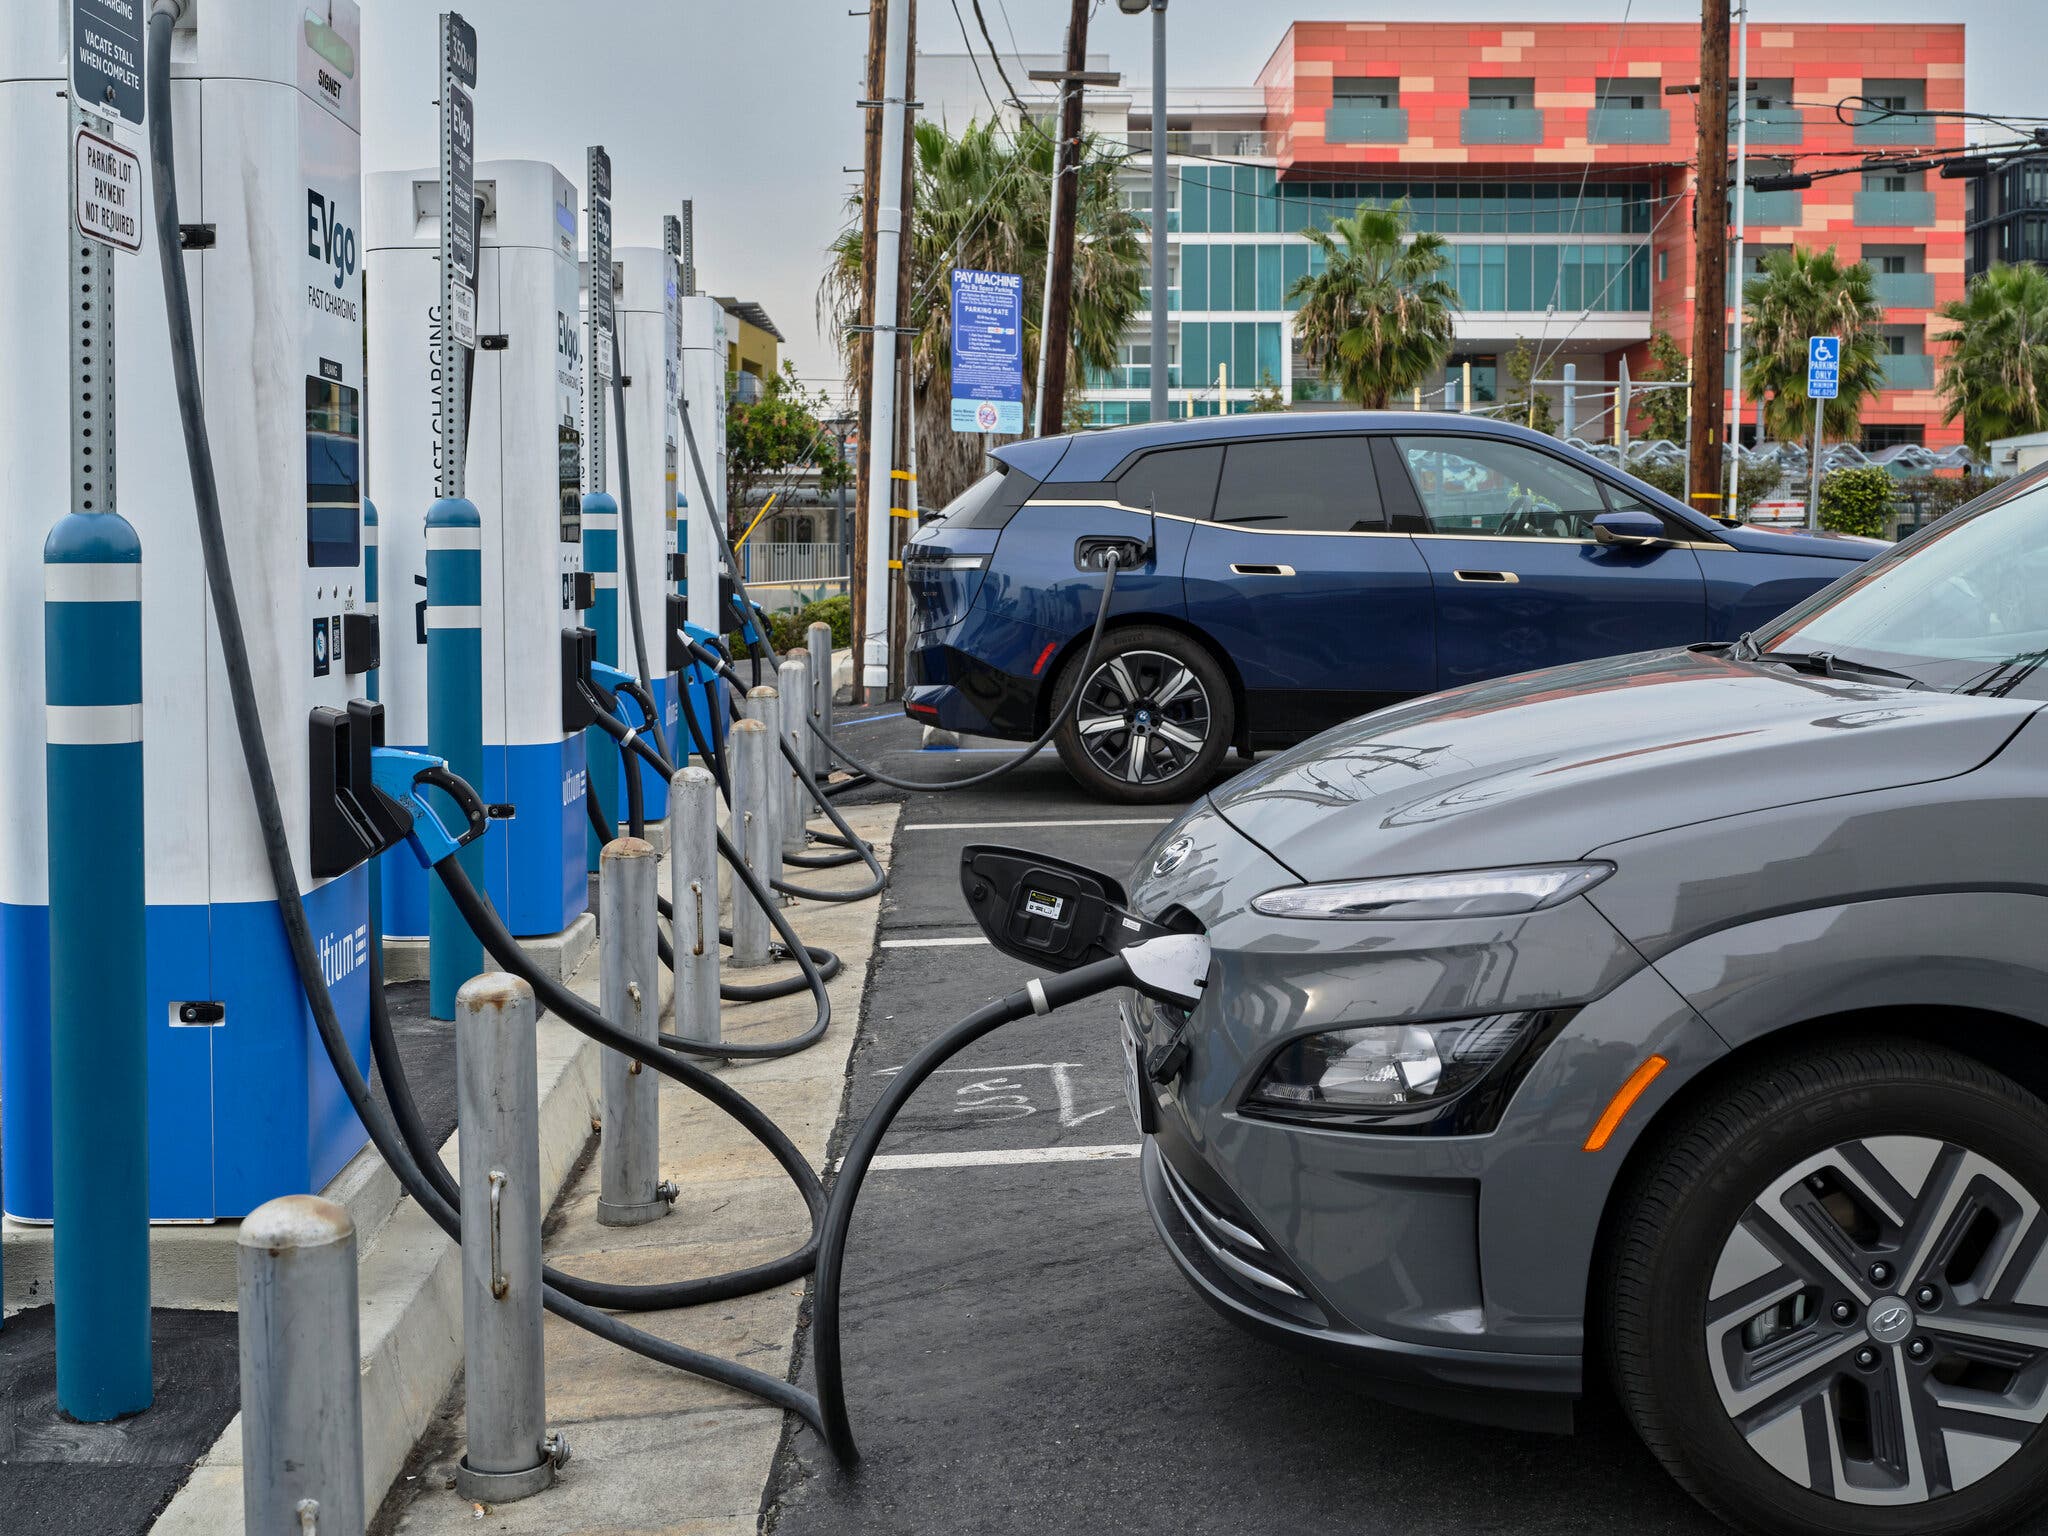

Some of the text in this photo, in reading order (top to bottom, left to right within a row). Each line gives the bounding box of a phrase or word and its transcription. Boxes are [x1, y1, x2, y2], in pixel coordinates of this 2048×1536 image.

[98, 0, 133, 20] ARGING
[85, 29, 135, 68] VACATE STALL
[80, 47, 140, 90] WHEN COMPLETE
[318, 69, 342, 100] SIGNET
[453, 103, 470, 148] EVgo
[87, 146, 131, 184] PARKING LOT
[94, 177, 125, 207] PAYMENT
[85, 200, 135, 237] NOT REQUIRED
[307, 187, 356, 290] EVgo
[954, 271, 1020, 288] PAY MACHINE
[994, 286, 1014, 294] Parking
[308, 285, 357, 322] FAST CHARGING
[964, 306, 1009, 316] PARKING RATE
[557, 310, 578, 371] EVgo
[1810, 361, 1838, 370] PARKING
[1815, 371, 1832, 380] ONLY
[319, 932, 354, 987] ltium
